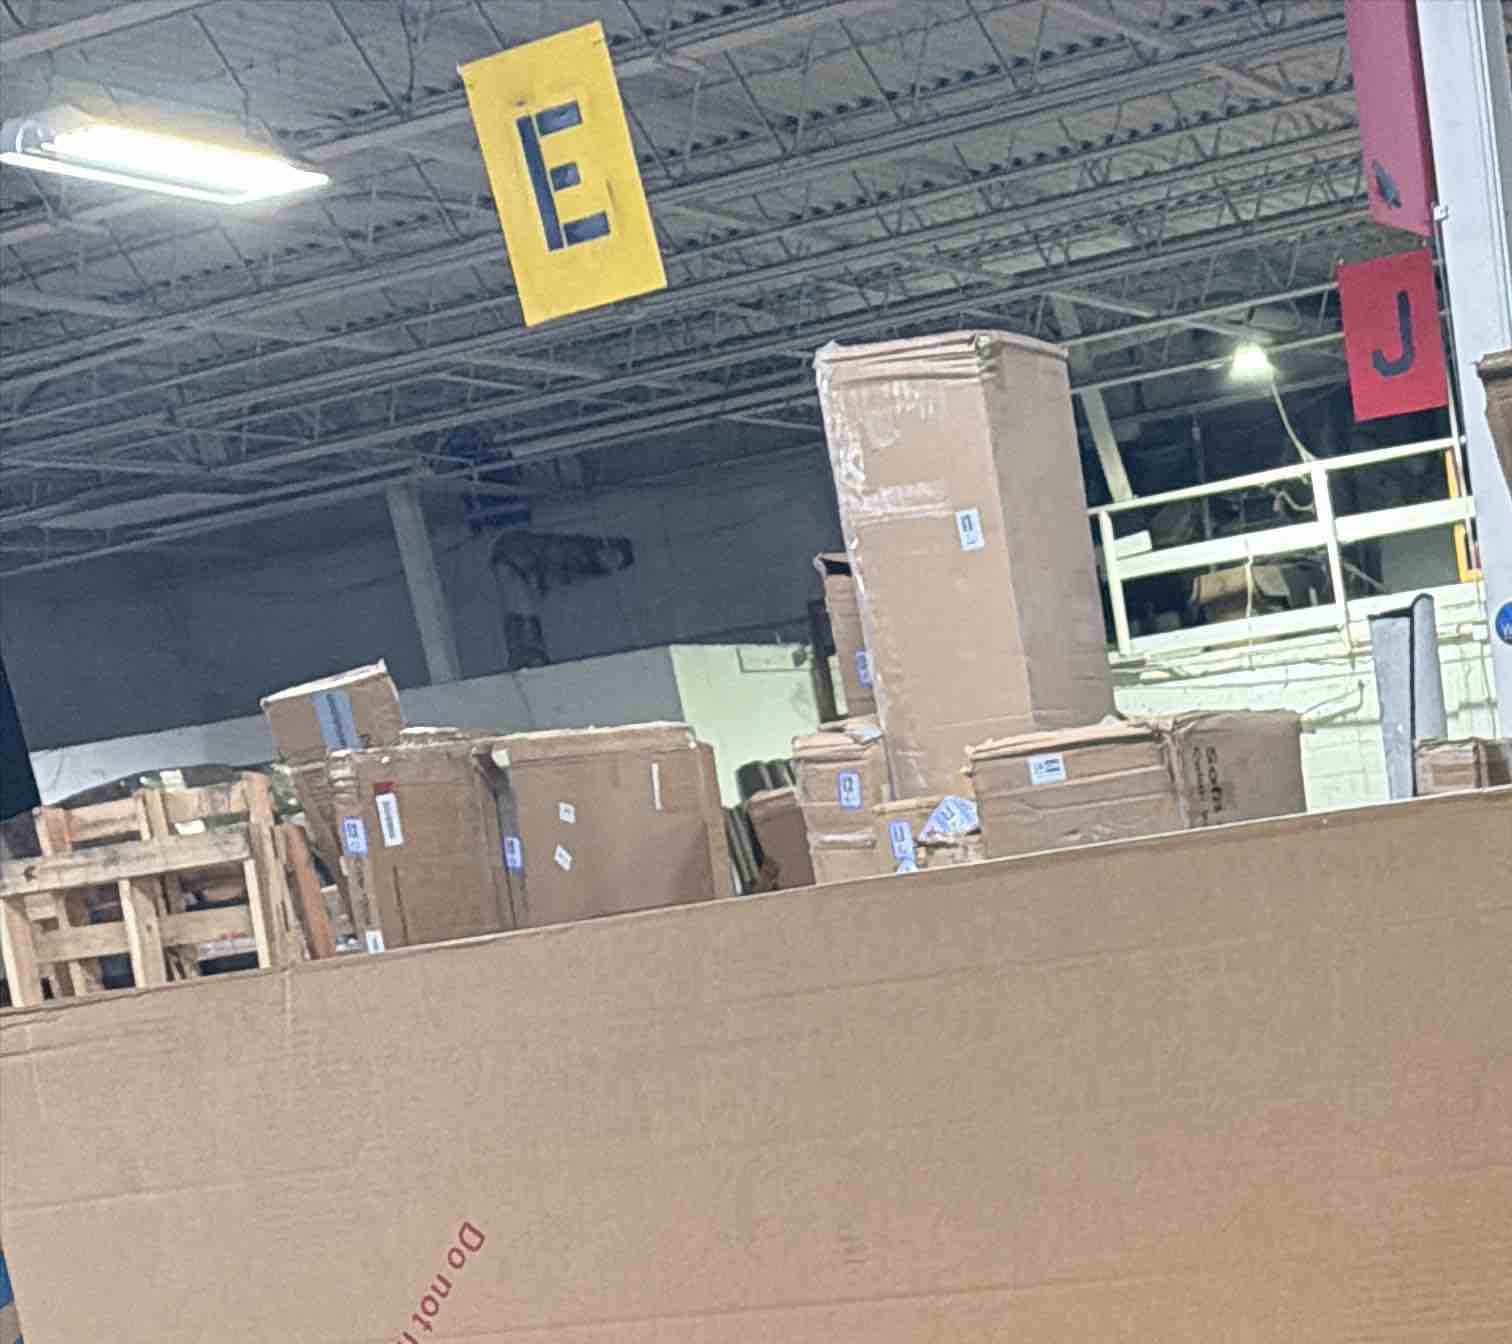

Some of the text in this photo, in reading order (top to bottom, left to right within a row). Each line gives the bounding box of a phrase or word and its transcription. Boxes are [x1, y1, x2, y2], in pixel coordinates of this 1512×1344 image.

[516, 99, 612, 252] E
[1372, 291, 1415, 378] J
[448, 1221, 486, 1270] Do
[412, 1273, 453, 1334] not
